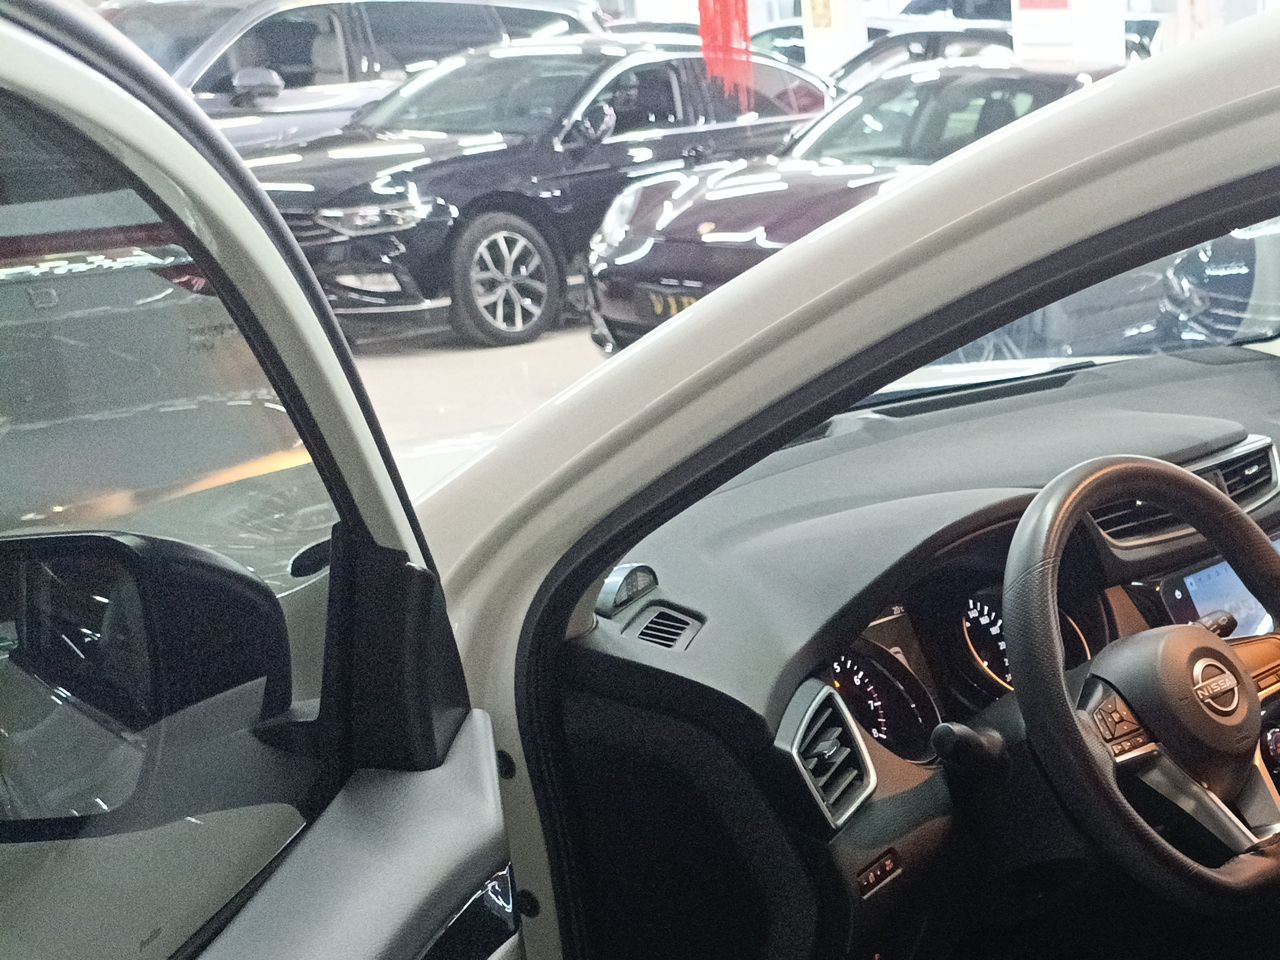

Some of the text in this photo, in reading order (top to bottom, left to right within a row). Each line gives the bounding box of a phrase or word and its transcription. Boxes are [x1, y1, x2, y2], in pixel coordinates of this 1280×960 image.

[833, 662, 841, 673] 5
[853, 675, 861, 685] 6
[1196, 676, 1235, 699] NISSA
[867, 700, 874, 710] 7
[871, 728, 879, 738] 8
